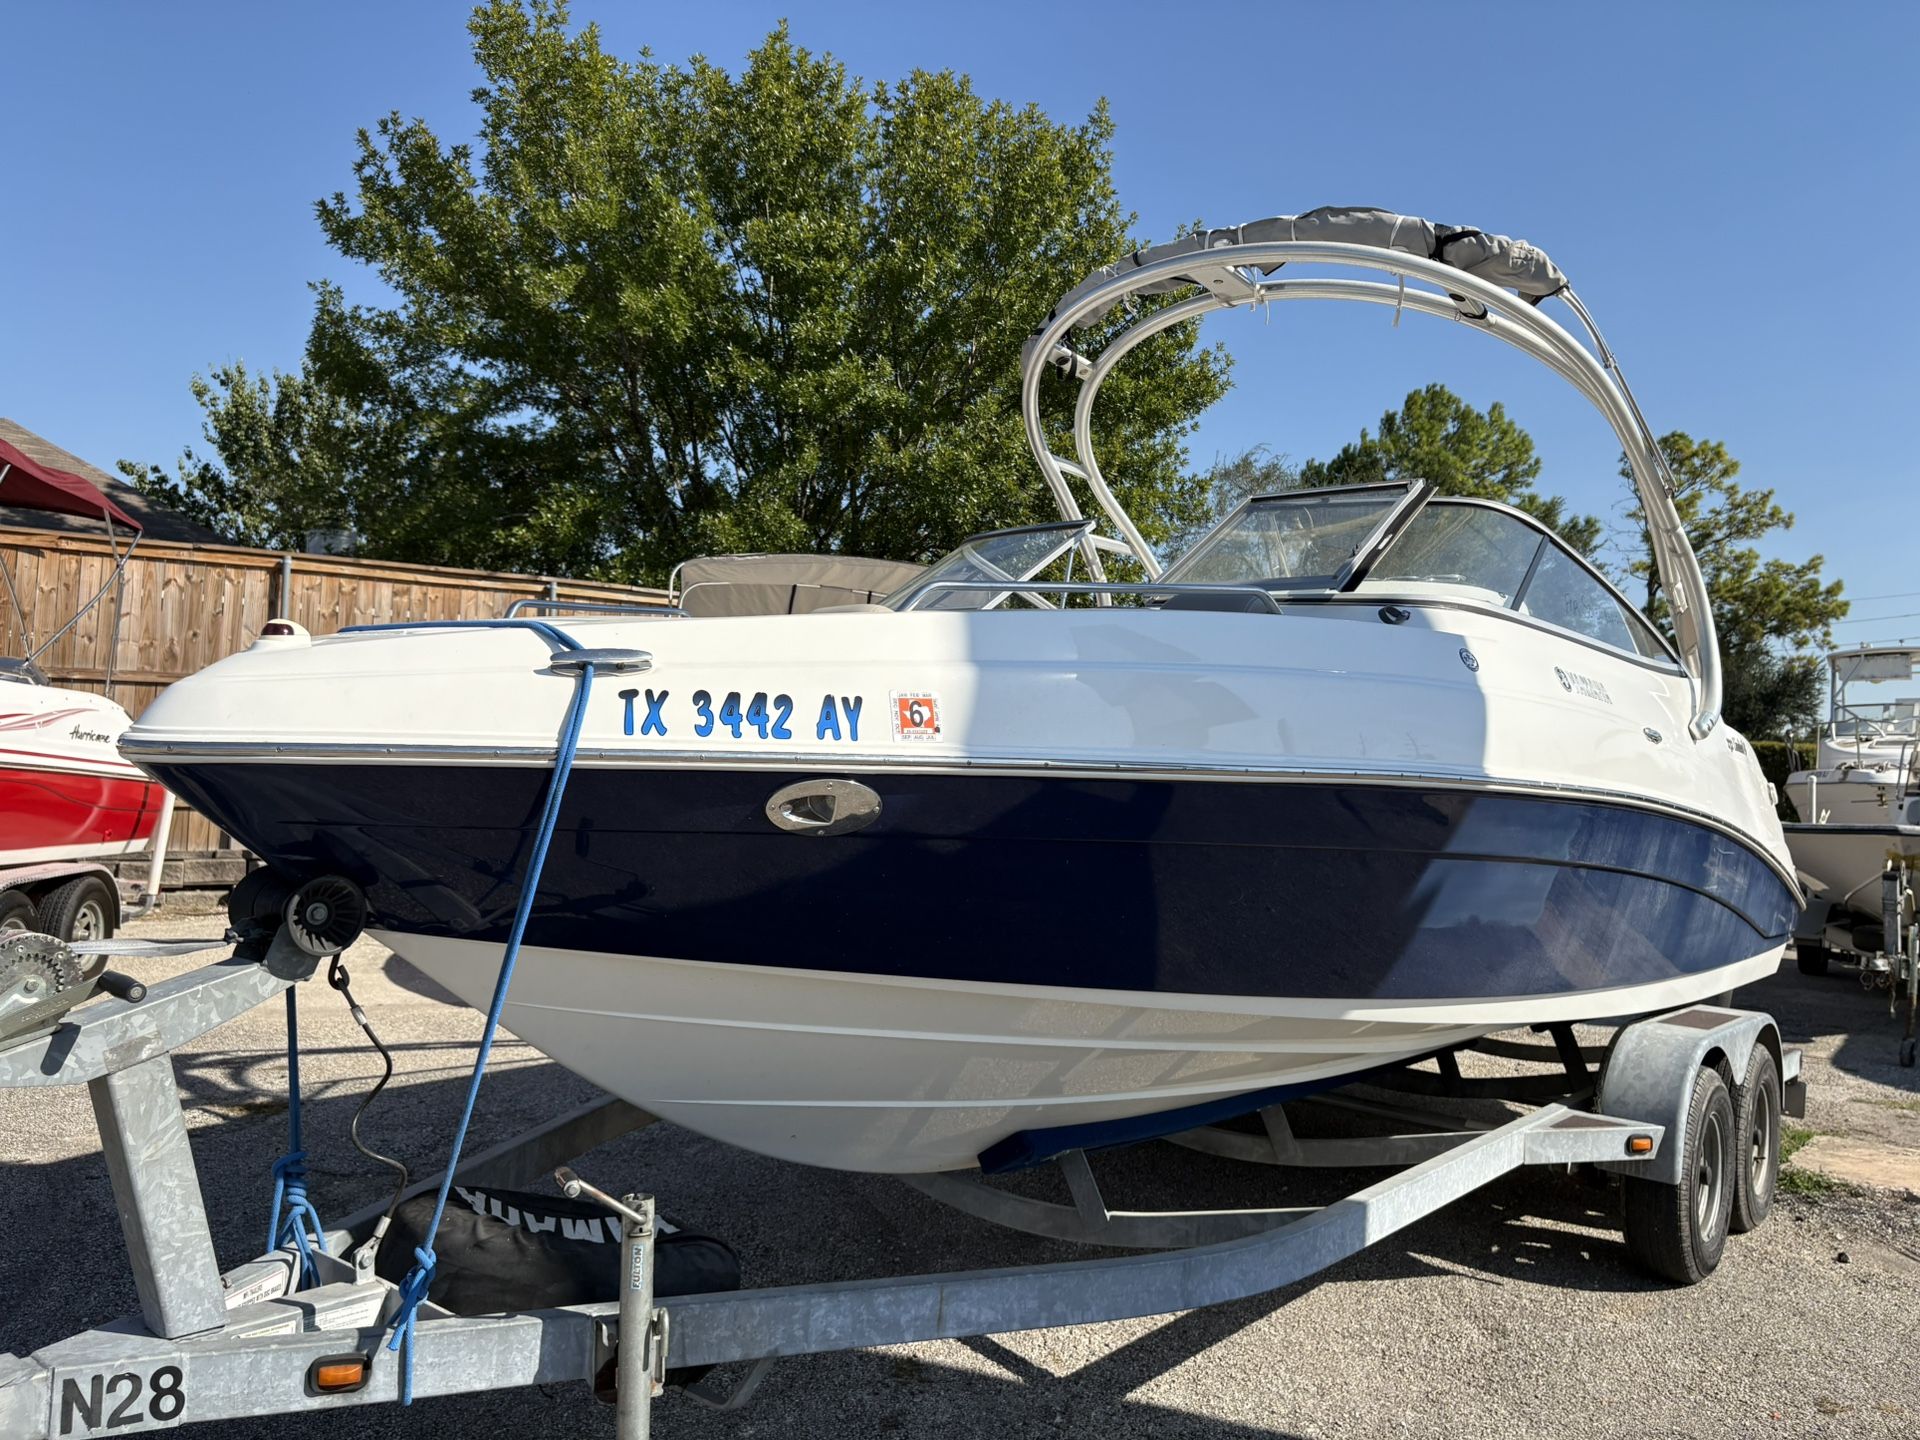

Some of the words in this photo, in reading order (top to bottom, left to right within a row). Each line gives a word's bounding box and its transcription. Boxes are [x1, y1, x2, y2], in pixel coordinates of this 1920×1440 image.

[618, 688, 669, 736] TX
[692, 690, 794, 739] 3442
[816, 694, 863, 741] AY
[910, 700, 924, 728] 6
[633, 1247, 642, 1288] FULTON
[60, 1365, 185, 1435] N28
